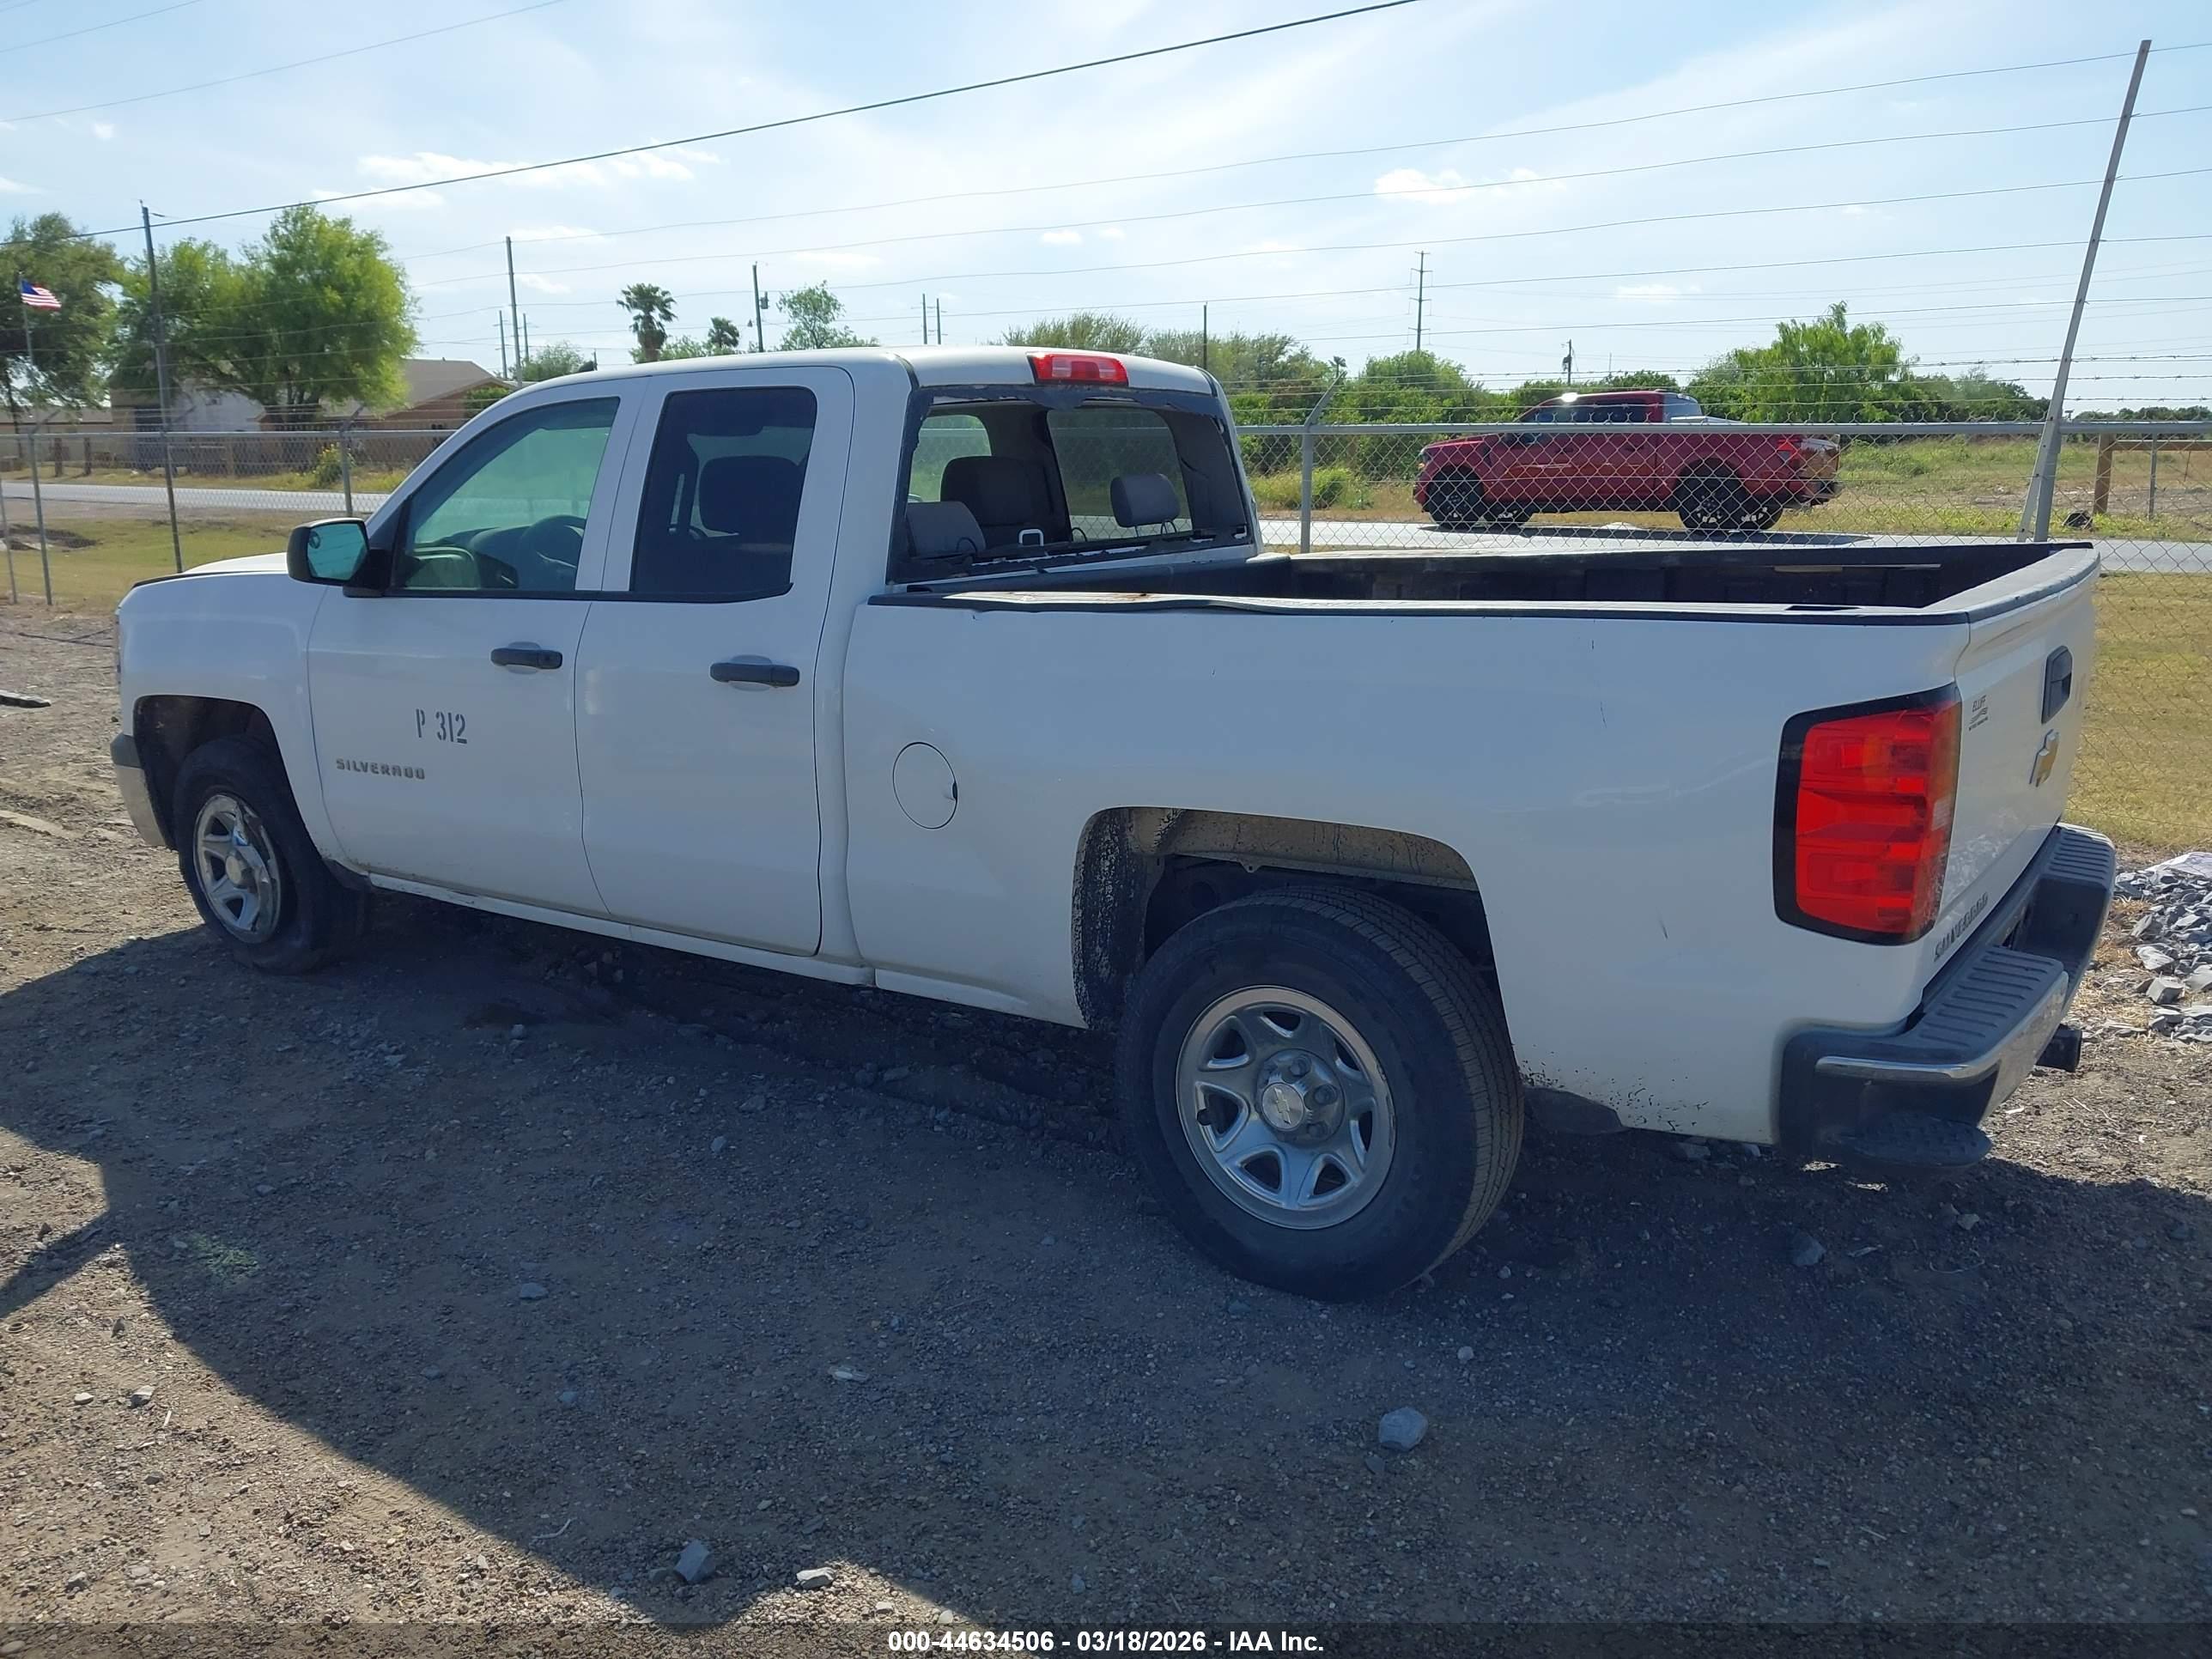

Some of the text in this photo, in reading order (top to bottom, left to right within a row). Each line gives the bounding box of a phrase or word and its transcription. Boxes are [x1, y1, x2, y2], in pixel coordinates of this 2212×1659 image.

[416, 708, 468, 744] P 312
[336, 757, 426, 781] SILVERADO
